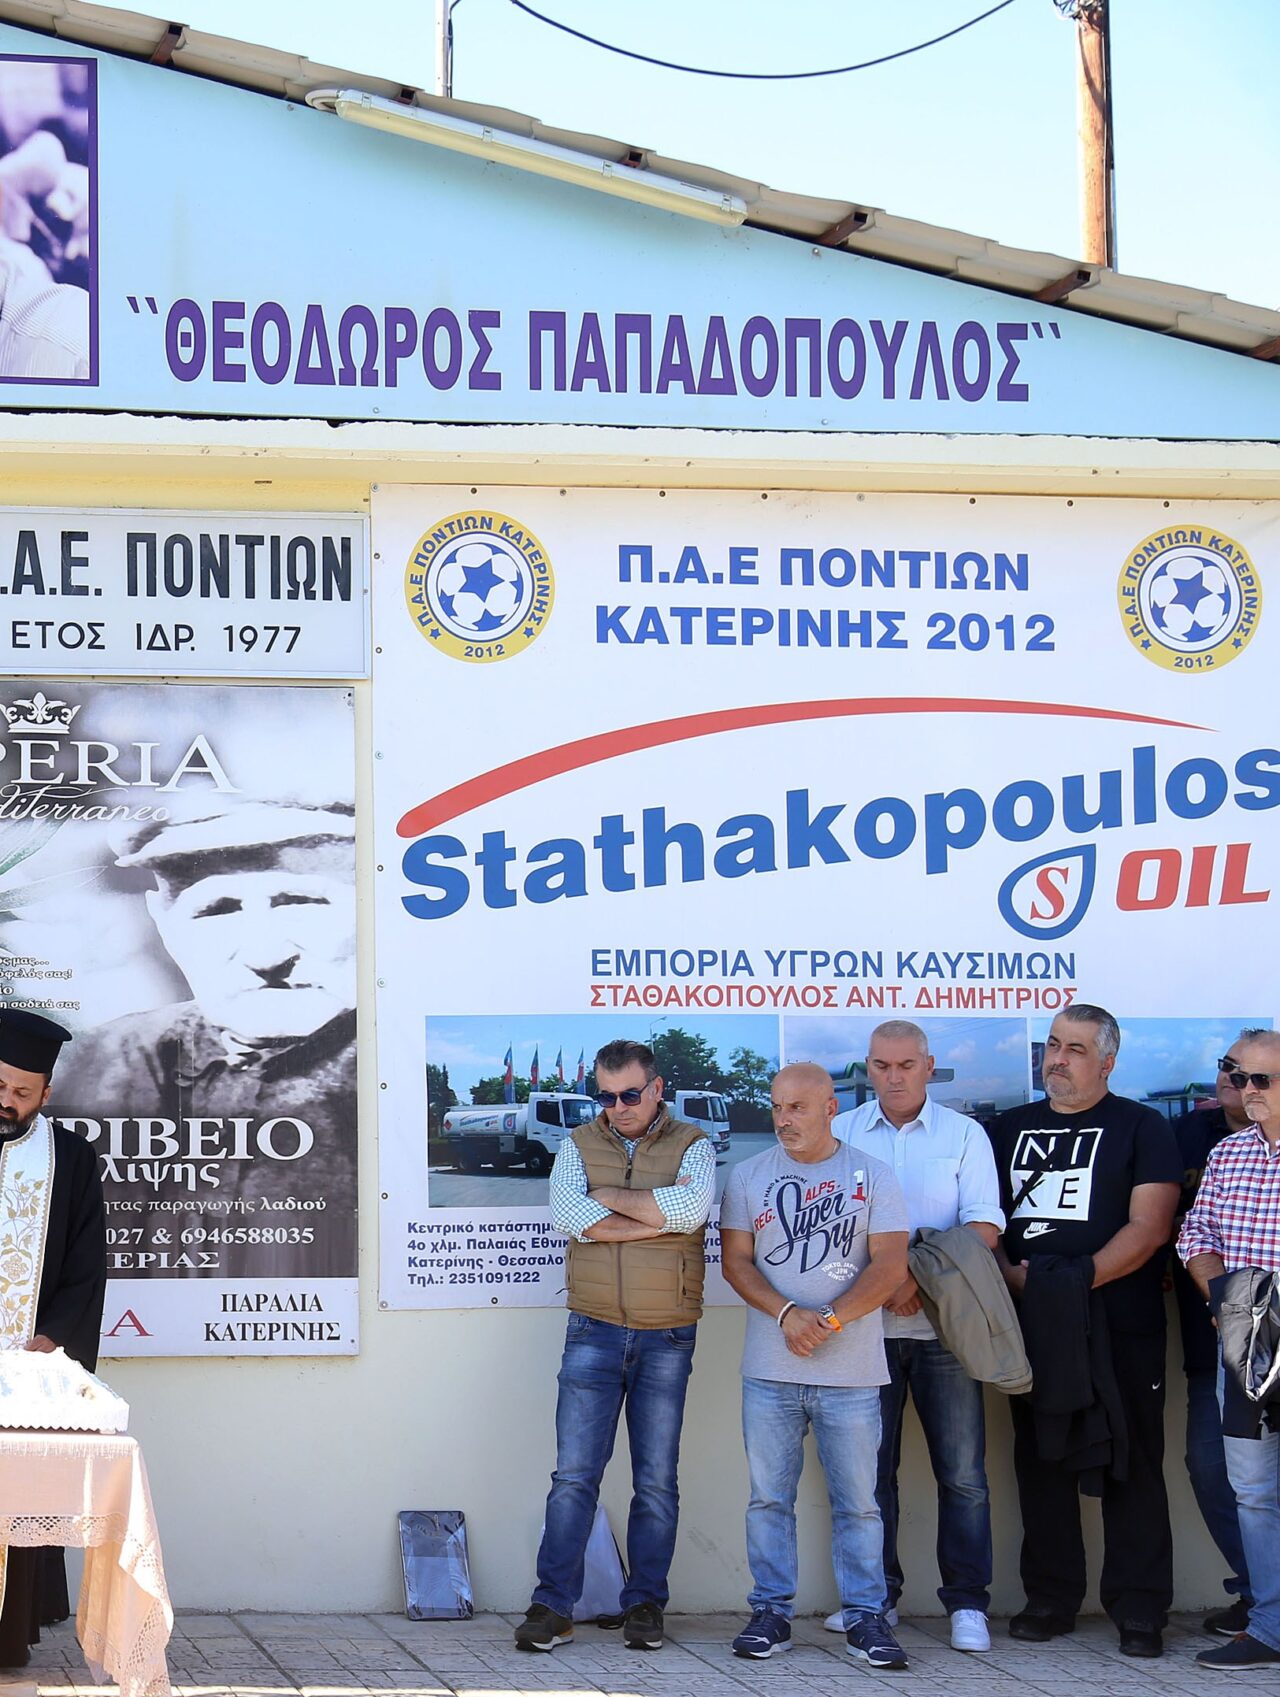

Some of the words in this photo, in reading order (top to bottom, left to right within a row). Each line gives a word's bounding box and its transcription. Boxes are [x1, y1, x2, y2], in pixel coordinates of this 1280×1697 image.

[126, 532, 351, 602] ΠΟΝΤΙΩΝ
[413, 516, 493, 568] ΠΟΝΤΙΩΝ
[499, 522, 550, 626] ΚΑΤΕΡΙΝΗΣ
[618, 544, 760, 585] Π.Α.Ε
[780, 548, 1029, 591] ΠΟΝΤΙΩΝ
[1125, 530, 1202, 580] ΠΟΝΤΙΩΝ
[1208, 536, 1258, 637] ΚΑΤΕΡΙΝΗΣ
[11, 621, 106, 650] ΕΤΟΣ
[136, 624, 196, 652] ΙΔΡ.
[223, 625, 302, 653] 1977
[596, 605, 908, 649] ΚΑΤΕΡΙΝΗΣ
[927, 613, 1055, 652] 2012
[464, 644, 505, 658] 2012
[1174, 655, 1214, 668] 2012
[400, 745, 1280, 920] Stathakopoulos
[1116, 843, 1270, 911] OIL
[591, 949, 754, 977] ΕΜΠΟΡΙΑ
[764, 950, 883, 978] ΥΓΡΩΝ
[897, 951, 1076, 980] ΚΑΥΣΙΜΩΝ
[10, 999, 53, 1009] σοδειά
[56, 1001, 81, 1011] σας
[590, 985, 838, 1008] ΣΤΑΘΑΚΟΠΟΥΛΟΣ
[846, 986, 905, 1008] ΑΝΤ.
[914, 986, 1078, 1009] ΔΗΜΗΤΡΙΟΣ
[148, 1197, 255, 1214] παραγωγής
[260, 1197, 326, 1211] λαδιού
[151, 1228, 173, 1244] &
[180, 1227, 314, 1245] 6946588035
[407, 1220, 474, 1236] Κεντρικό
[1028, 1221, 1050, 1232] NIKE
[407, 1239, 426, 1250] 4ο
[431, 1239, 461, 1253] χλμ.
[467, 1236, 526, 1251] Παλαιάς
[407, 1255, 484, 1269] Κατερίνης
[407, 1273, 444, 1287] Τηλ.:
[449, 1271, 541, 1285] 2351091222
[221, 1294, 323, 1313] ΠΑΡΑΛΙΑ
[204, 1322, 341, 1342] ΚΑΤΕΡΙΝΗΣ
